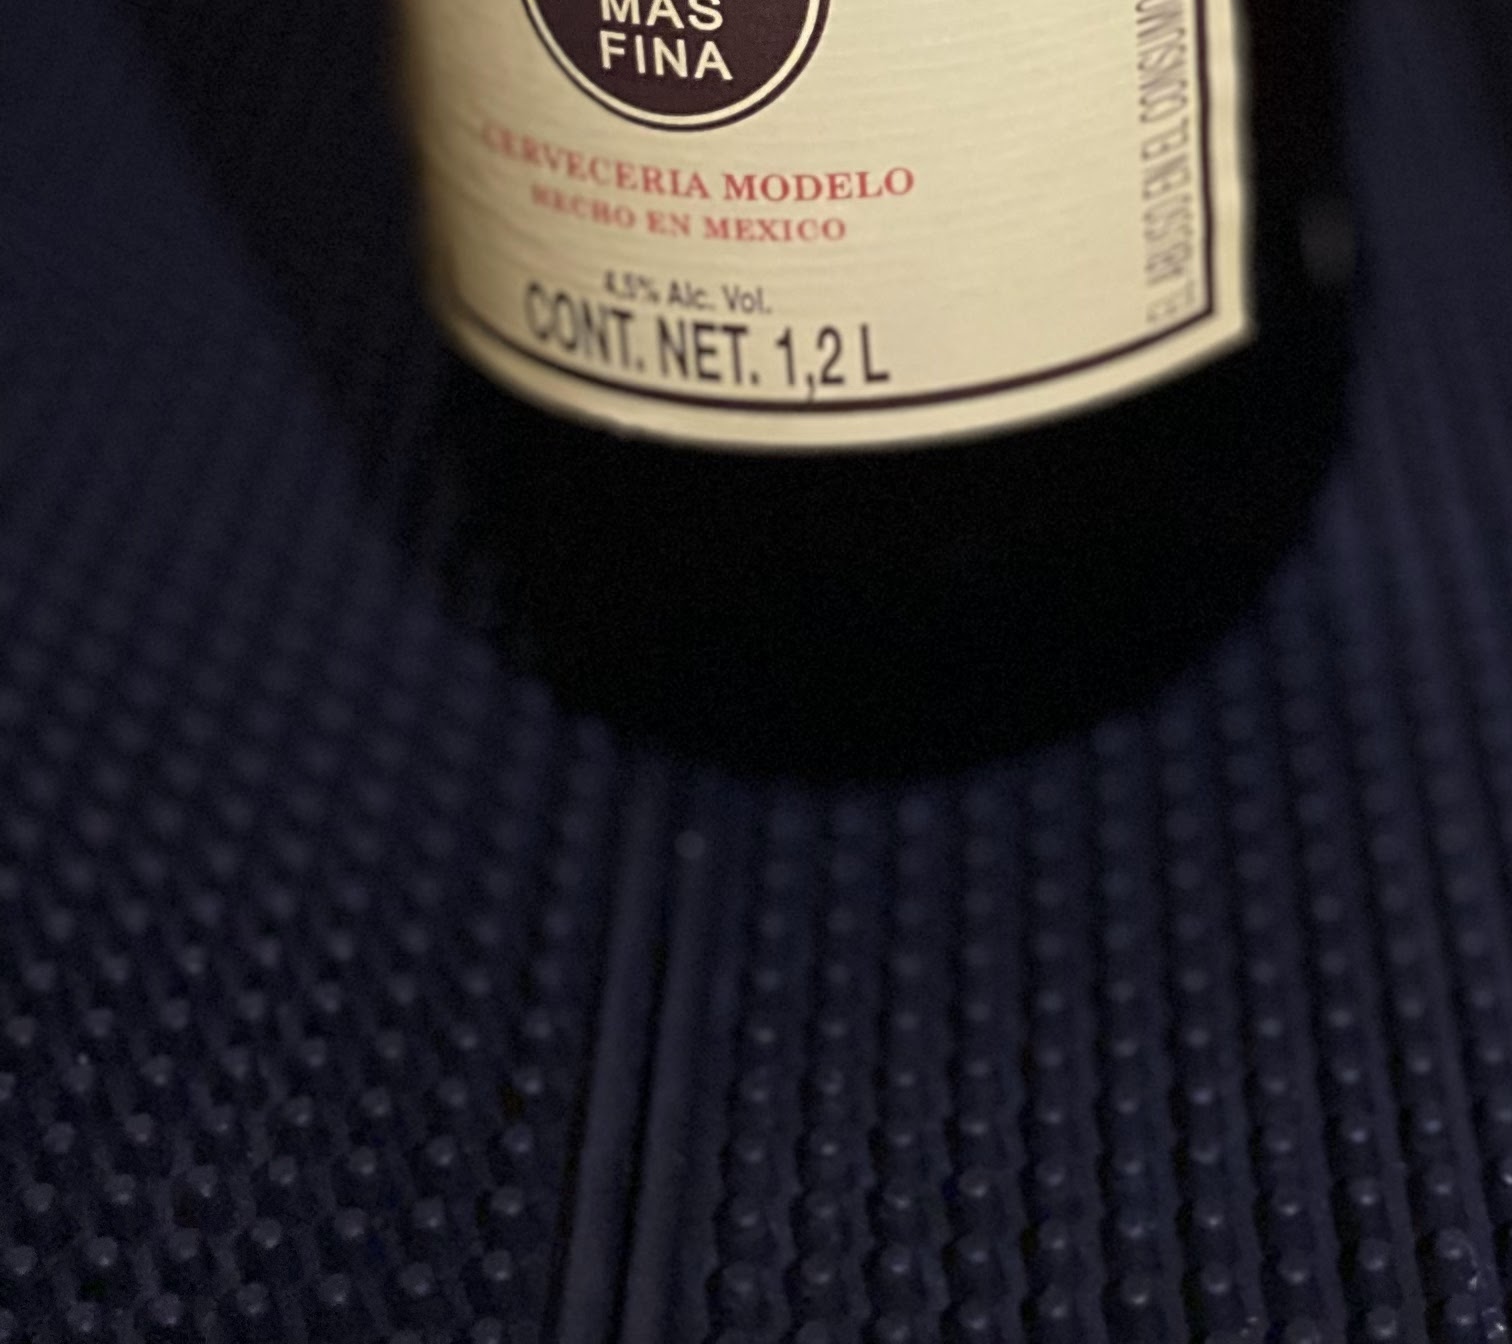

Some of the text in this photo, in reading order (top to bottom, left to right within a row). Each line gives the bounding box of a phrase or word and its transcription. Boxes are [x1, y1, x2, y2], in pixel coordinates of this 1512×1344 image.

[599, 30, 733, 81] FINA
[481, 119, 916, 203] CERVECERIA MODELO
[530, 183, 847, 243] HECHO EN MEXICO
[668, 280, 714, 312] Alc.
[722, 284, 772, 315] Vol.
[524, 279, 891, 403] CONT. NET. 1,2 L
